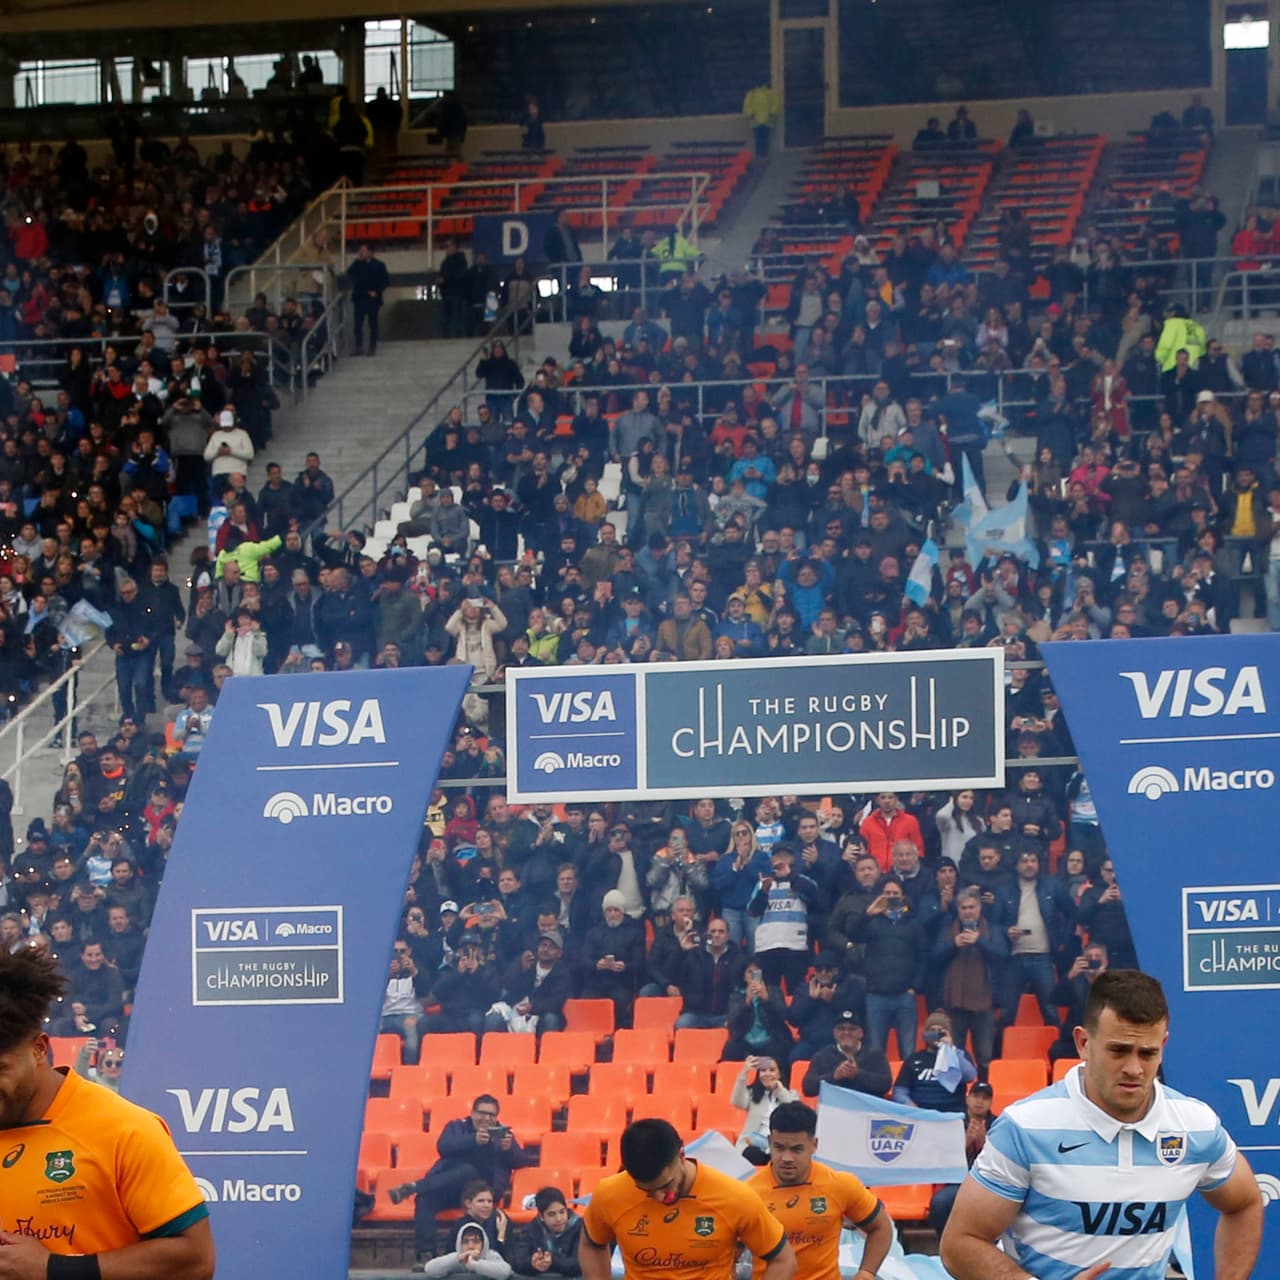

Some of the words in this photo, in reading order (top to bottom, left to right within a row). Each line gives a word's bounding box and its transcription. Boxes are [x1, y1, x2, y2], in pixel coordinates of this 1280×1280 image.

[502, 220, 529, 256] D
[749, 697, 796, 715] THE
[809, 693, 889, 713] RUGBY
[1119, 666, 1267, 719] VISA
[529, 690, 617, 723] VISA
[671, 676, 970, 758] CHAMPIONSHIP
[256, 699, 386, 747] VISA
[567, 751, 621, 769] Macro
[1184, 767, 1275, 792] Macro
[312, 793, 393, 816] Macro
[1194, 899, 1259, 922] VISA
[202, 920, 259, 942] VISA
[296, 923, 333, 935] Macro
[1236, 945, 1259, 954] THE
[206, 960, 329, 990] CHAMPIONSHIP
[239, 963, 258, 972] THE
[263, 962, 296, 972] RUGBY
[166, 1087, 294, 1132] VISA
[871, 1139, 906, 1152] UAR
[1161, 1149, 1181, 1157] UAR
[223, 1180, 301, 1202] Macro
[1071, 1201, 1167, 1236] VISA
